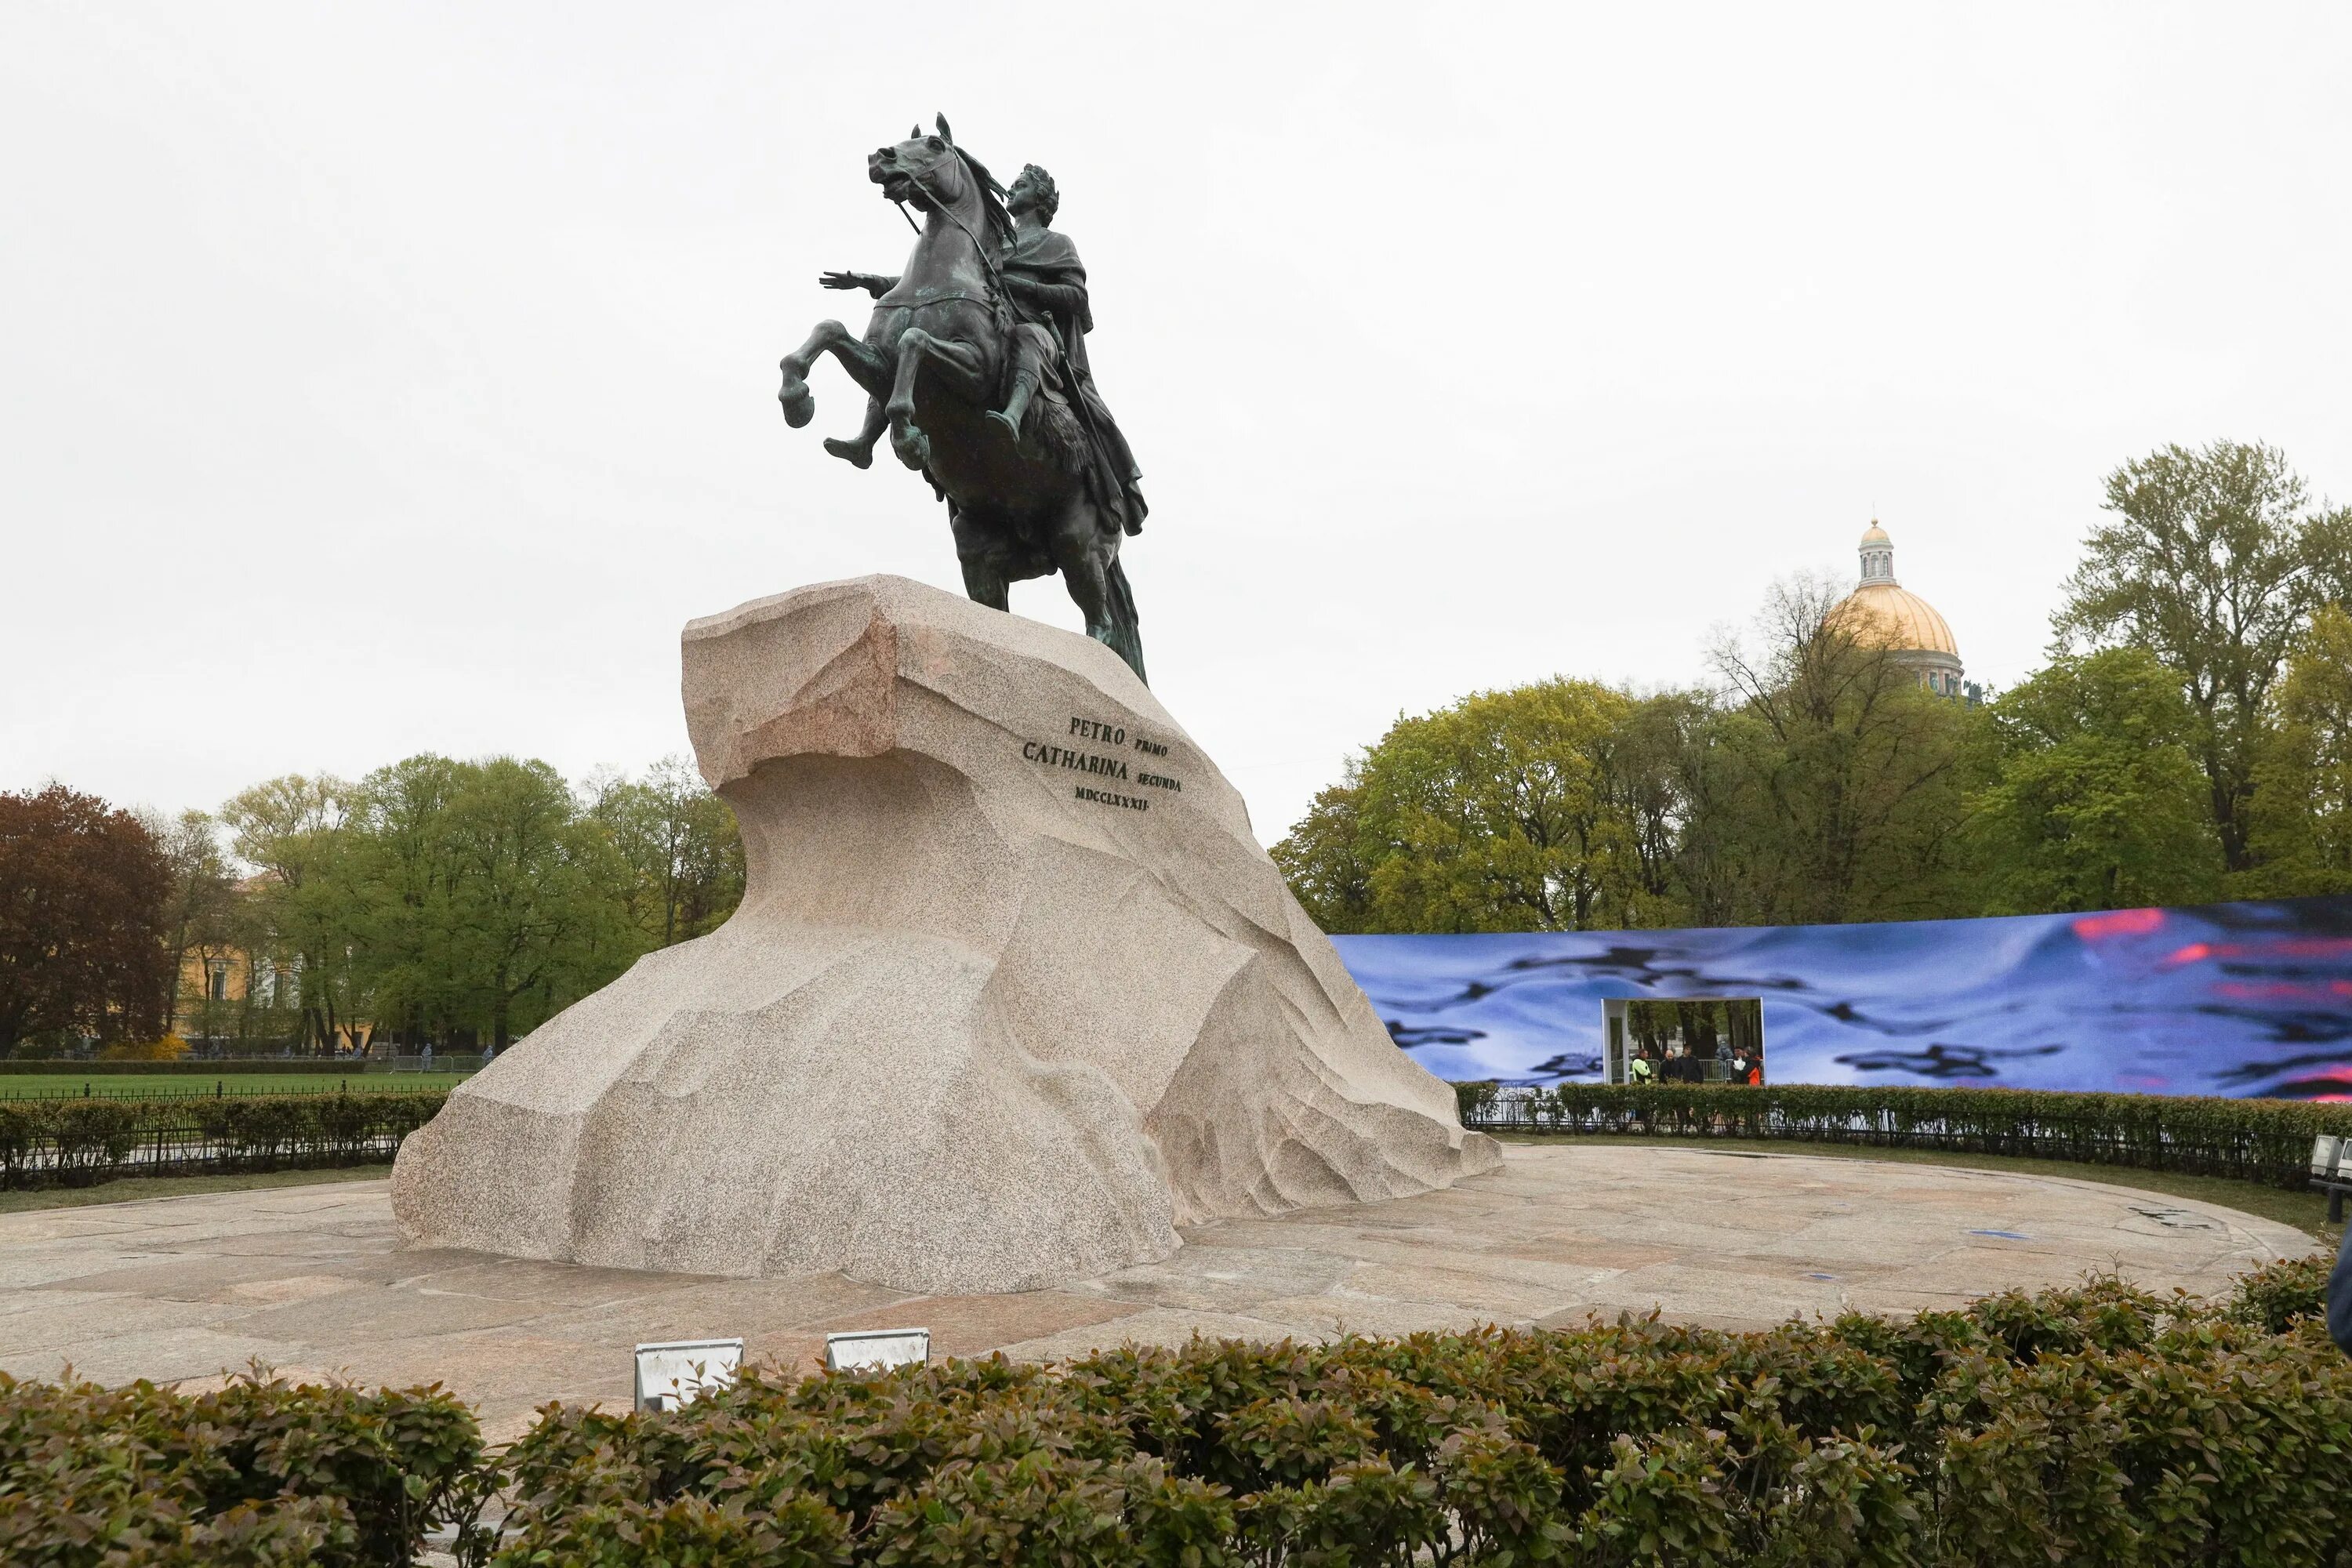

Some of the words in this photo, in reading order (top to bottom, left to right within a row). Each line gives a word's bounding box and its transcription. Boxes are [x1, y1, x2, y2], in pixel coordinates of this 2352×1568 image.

[1069, 717, 1125, 744] PETRO
[1135, 739, 1167, 757] PRIMO
[1023, 742, 1127, 779] CATHARINA
[1138, 772, 1181, 792] SECUNDA
